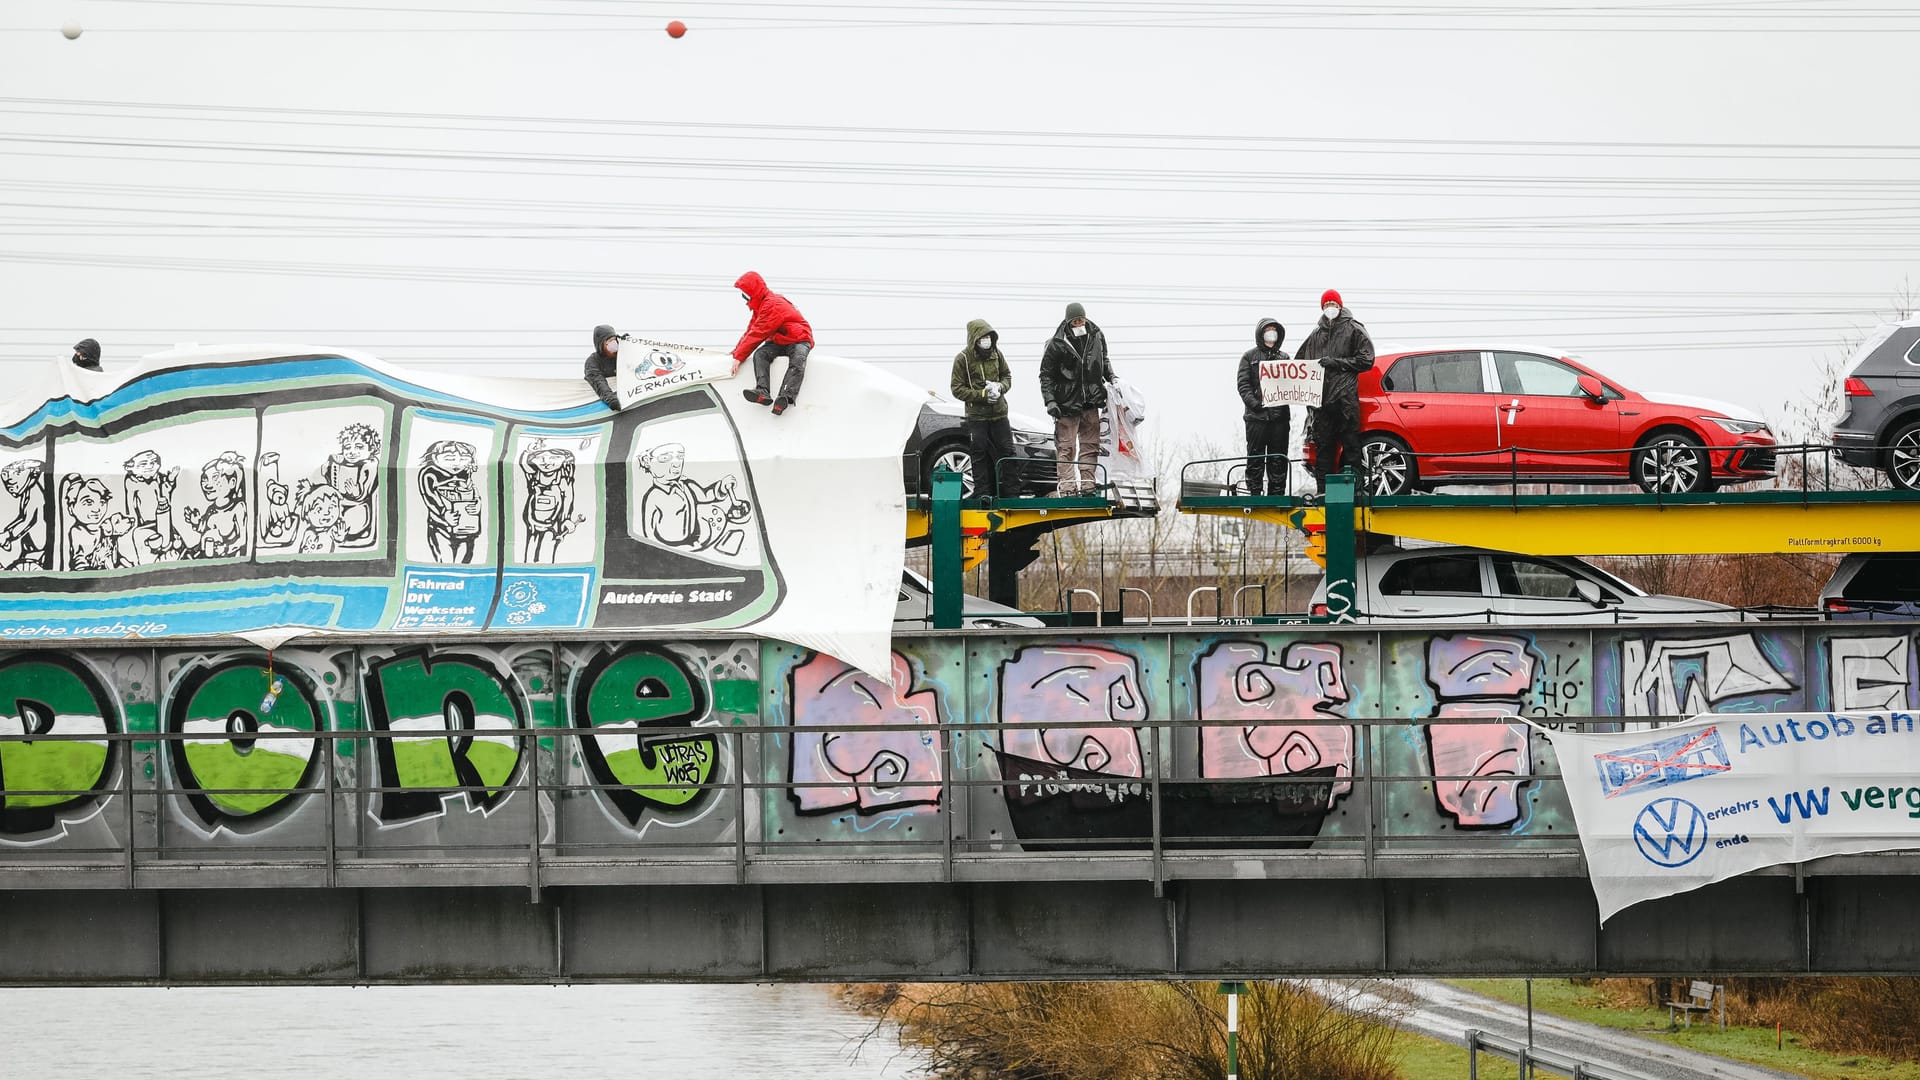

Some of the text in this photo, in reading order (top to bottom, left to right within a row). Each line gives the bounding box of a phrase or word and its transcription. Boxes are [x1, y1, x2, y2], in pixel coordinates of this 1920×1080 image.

[624, 336, 704, 353] EUTSCHLANDTAKT?
[1260, 363, 1308, 380] AUTOS
[627, 369, 703, 398] VERKACKT!
[1788, 537, 1882, 547] Plattformtragkraft 6000 kg
[408, 578, 465, 590] Fahrrad
[406, 593, 433, 603] DIY
[602, 589, 733, 604] Autofreie Stadt
[404, 606, 476, 615] Werkstatt
[73, 622, 168, 634] website
[1707, 798, 1760, 821] erkehrs
[1768, 786, 1920, 824] VW verg
[1715, 834, 1750, 850] ende
